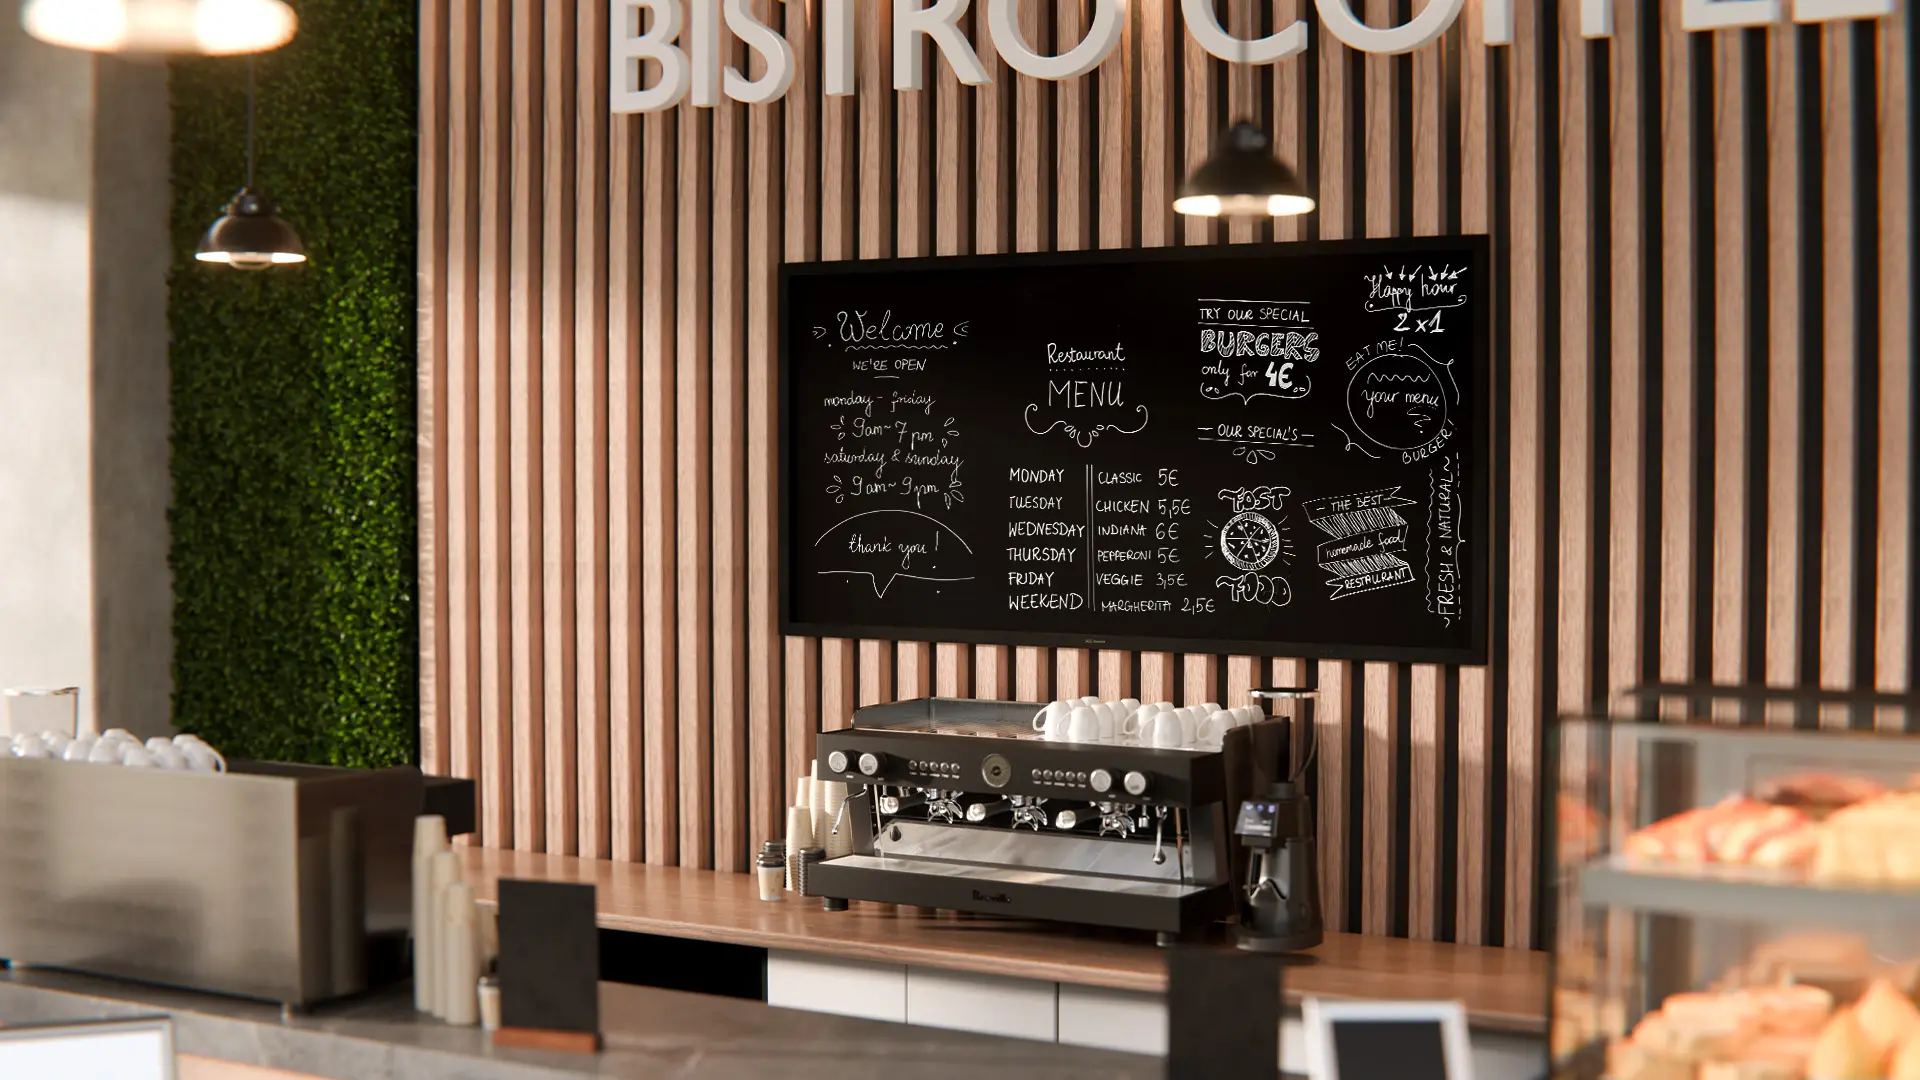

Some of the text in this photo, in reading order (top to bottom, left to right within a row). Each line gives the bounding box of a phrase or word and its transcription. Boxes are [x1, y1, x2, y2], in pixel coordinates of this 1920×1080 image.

[1364, 273, 1457, 313] Happy hour
[1199, 307, 1310, 323] TRY OUR SPECIAL
[837, 309, 944, 342] Welcome
[1047, 342, 1126, 364] Restaurant
[1200, 329, 1321, 363] BURGERS
[1345, 337, 1404, 371] EAT ME!
[852, 358, 927, 371] WE'RE OPEN
[1201, 360, 1294, 390] only for 4€
[824, 390, 874, 417] monday
[890, 390, 936, 415] friday
[1048, 380, 1124, 408] MENU
[1361, 389, 1439, 419] your menu
[1217, 423, 1298, 441] OUR SPECIAL'S
[824, 446, 964, 483] saturday & sunday
[1009, 467, 1065, 483] MONDAY
[1098, 468, 1179, 487] CLASSIC 5€
[1009, 495, 1063, 510] TUESDAY
[1095, 498, 1191, 519] CHICKEN 5,5€
[1331, 494, 1384, 512] THE BEST
[1008, 521, 1086, 538] WEDNESDAY
[1098, 524, 1148, 537] INDIANA
[848, 533, 893, 554] thank
[1326, 529, 1405, 559] homemade food
[1437, 472, 1456, 615] FRESH & NATURAL
[1006, 547, 1077, 563] THURSDAY
[1097, 547, 1180, 564] PEPPERONI 5€
[1008, 571, 1055, 587] FRIDAY
[1096, 572, 1188, 589] VEGGIE 3,5€
[1344, 566, 1409, 589] RESTAURANT
[1008, 593, 1084, 611] WEEKEND
[1101, 597, 1216, 615] MARGHERITA 2,5€
